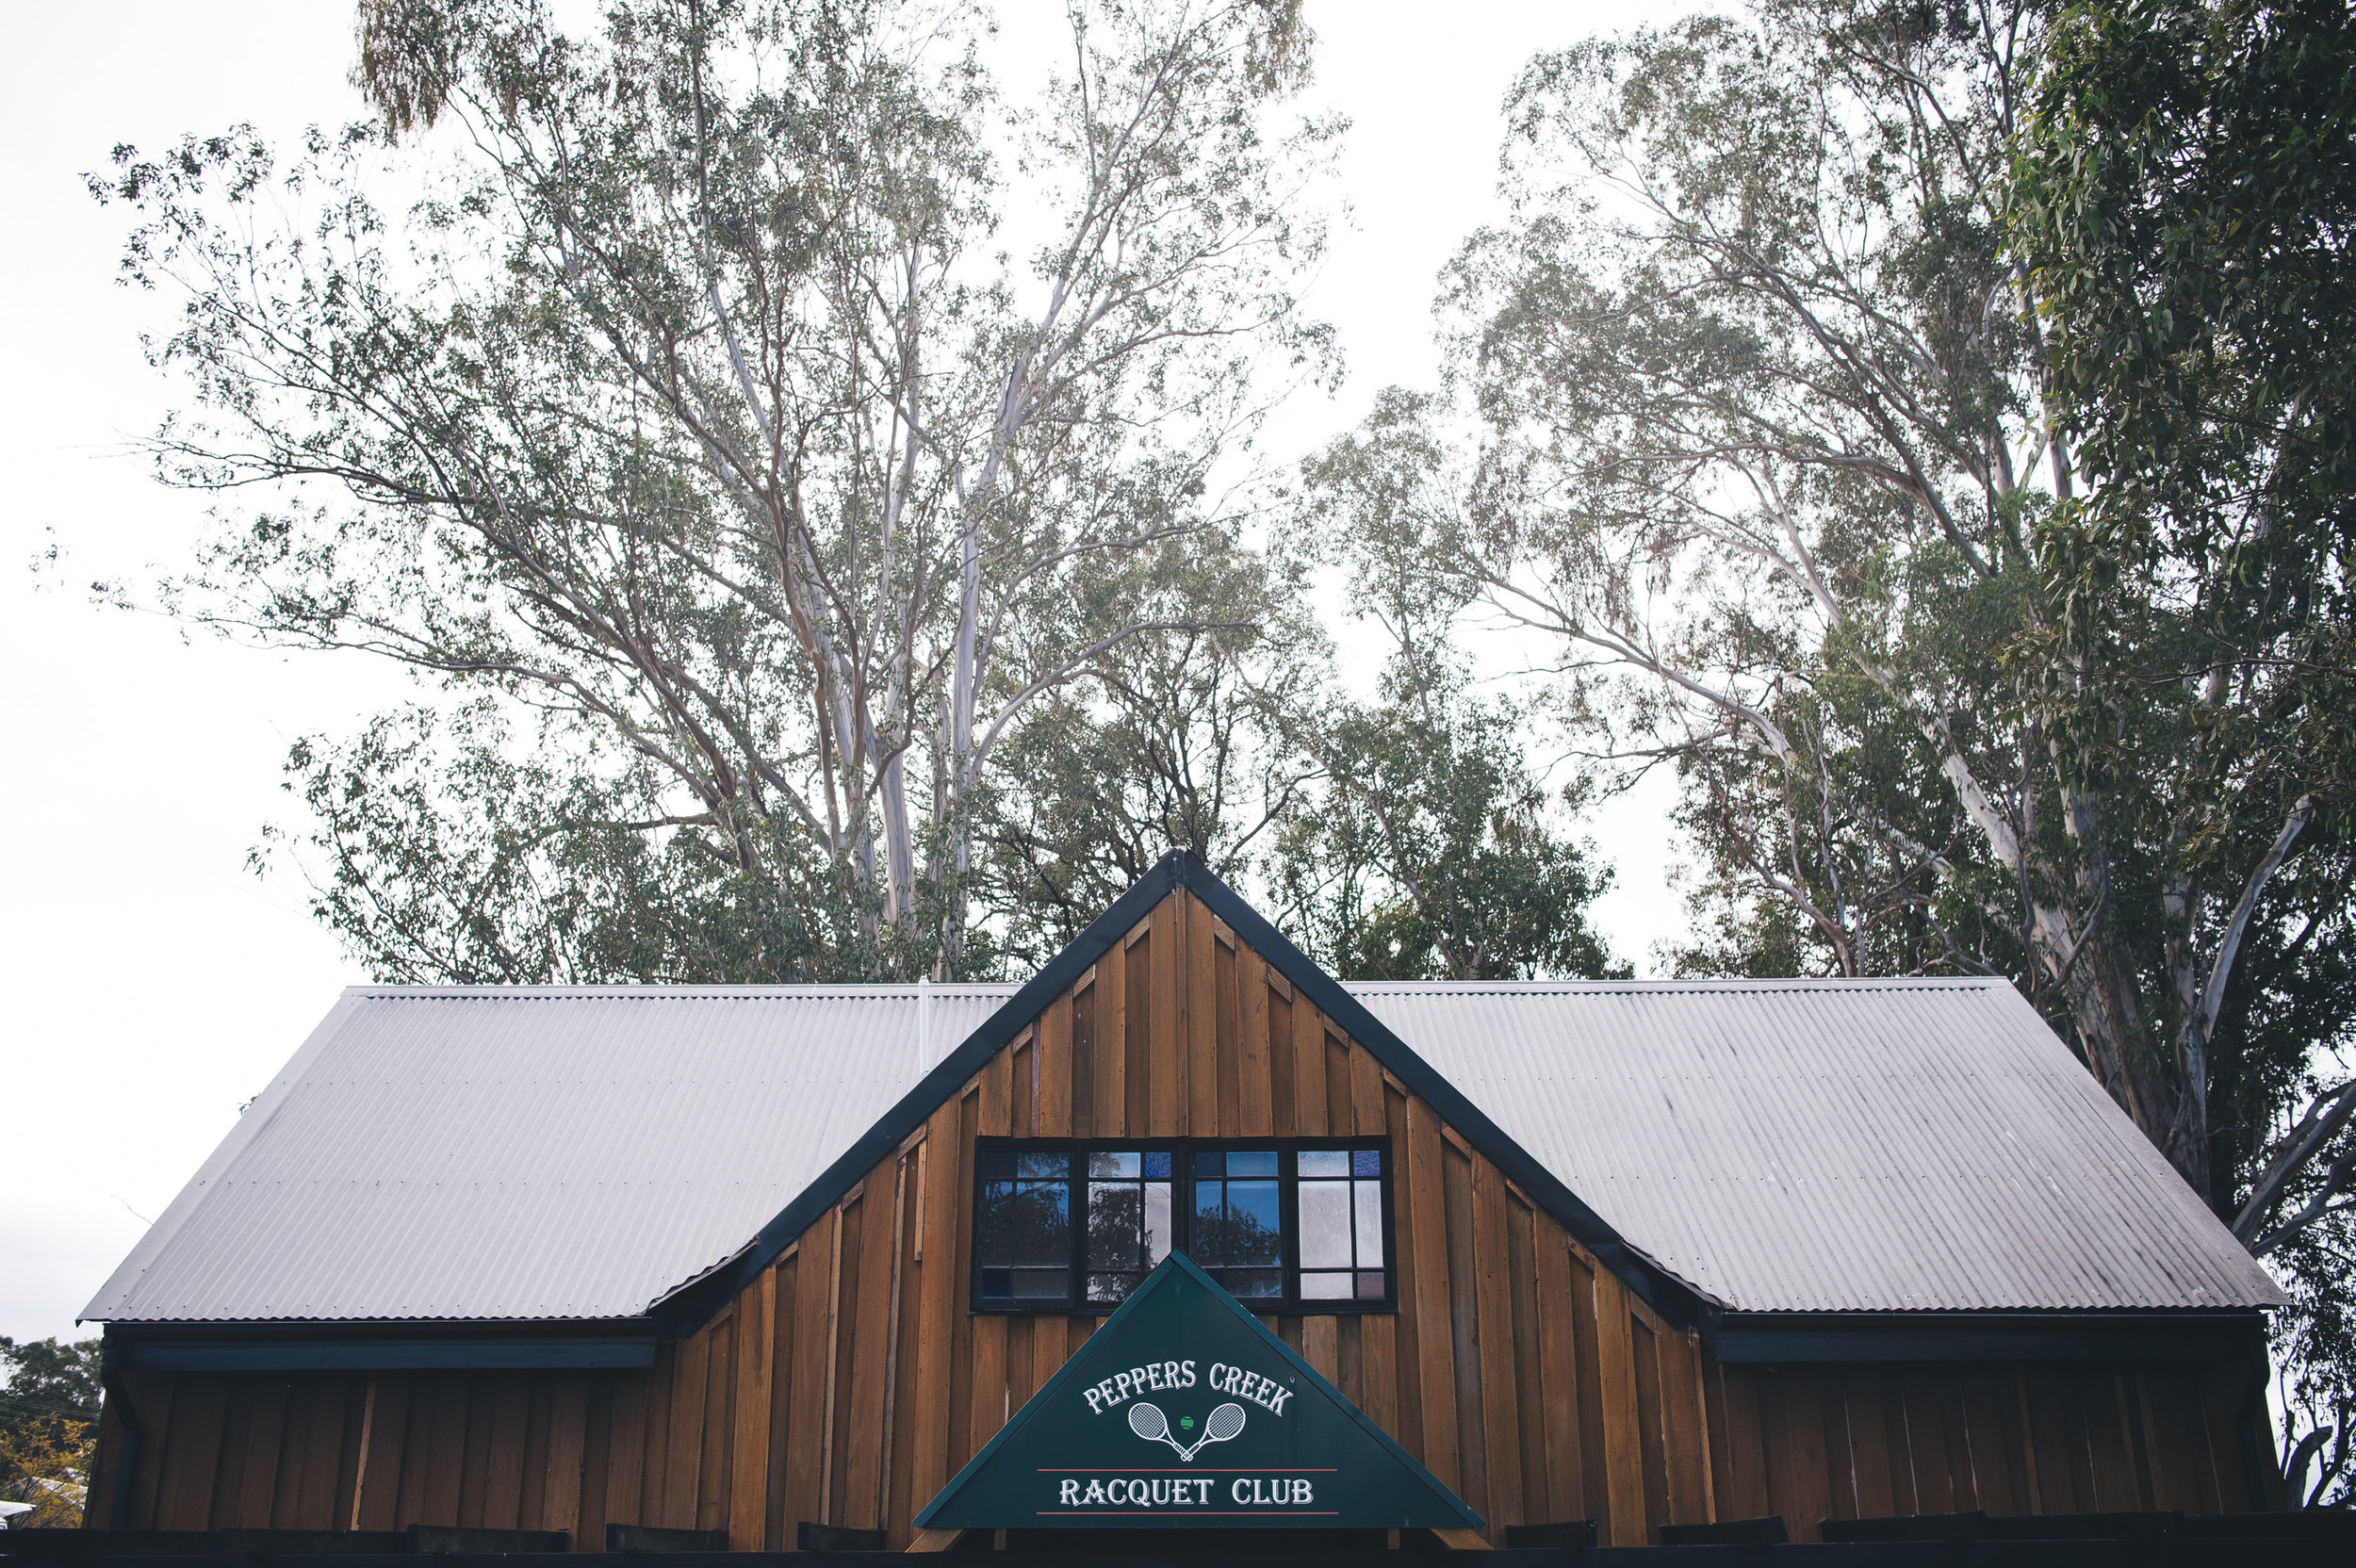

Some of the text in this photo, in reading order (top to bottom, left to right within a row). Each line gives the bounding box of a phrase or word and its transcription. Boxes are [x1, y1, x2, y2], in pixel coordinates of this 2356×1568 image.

[1083, 1360, 1294, 1417] PEPPERS CREEK
[1060, 1478, 1314, 1508] RACQUET CLUB
